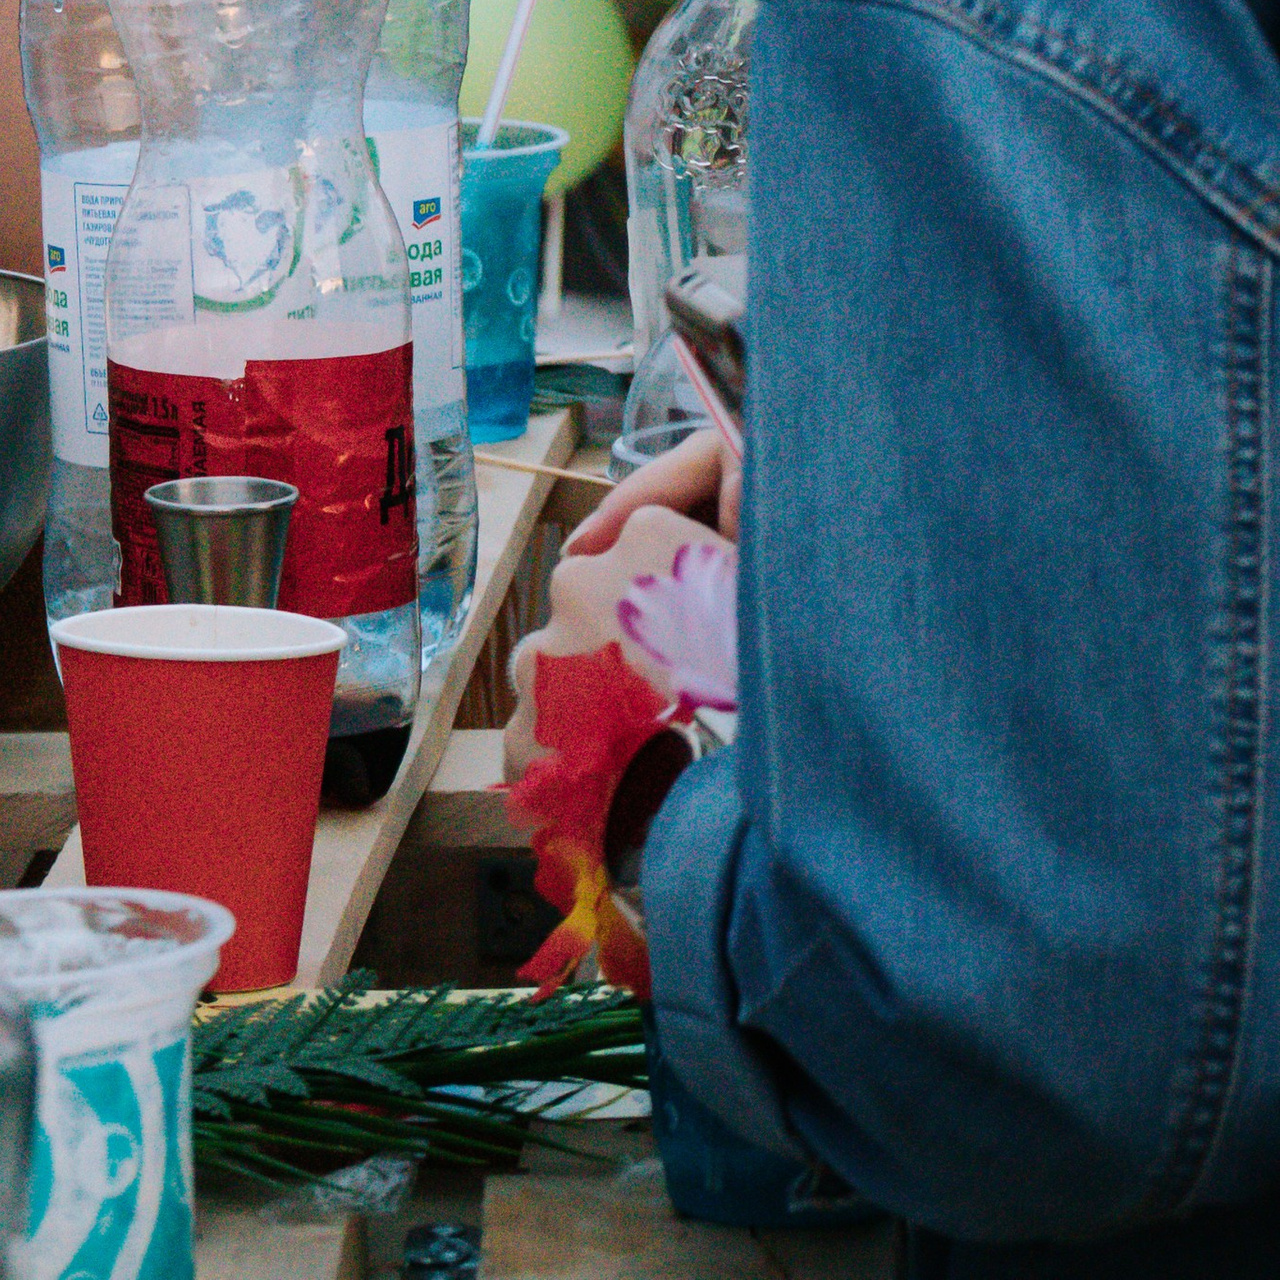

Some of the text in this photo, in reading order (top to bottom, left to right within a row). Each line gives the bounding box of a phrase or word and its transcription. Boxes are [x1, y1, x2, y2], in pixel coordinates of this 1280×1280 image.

[81, 195, 99, 205] ВОДА
[82, 208, 116, 220] ПИТЬЕВАЯ
[419, 201, 437, 215] aro
